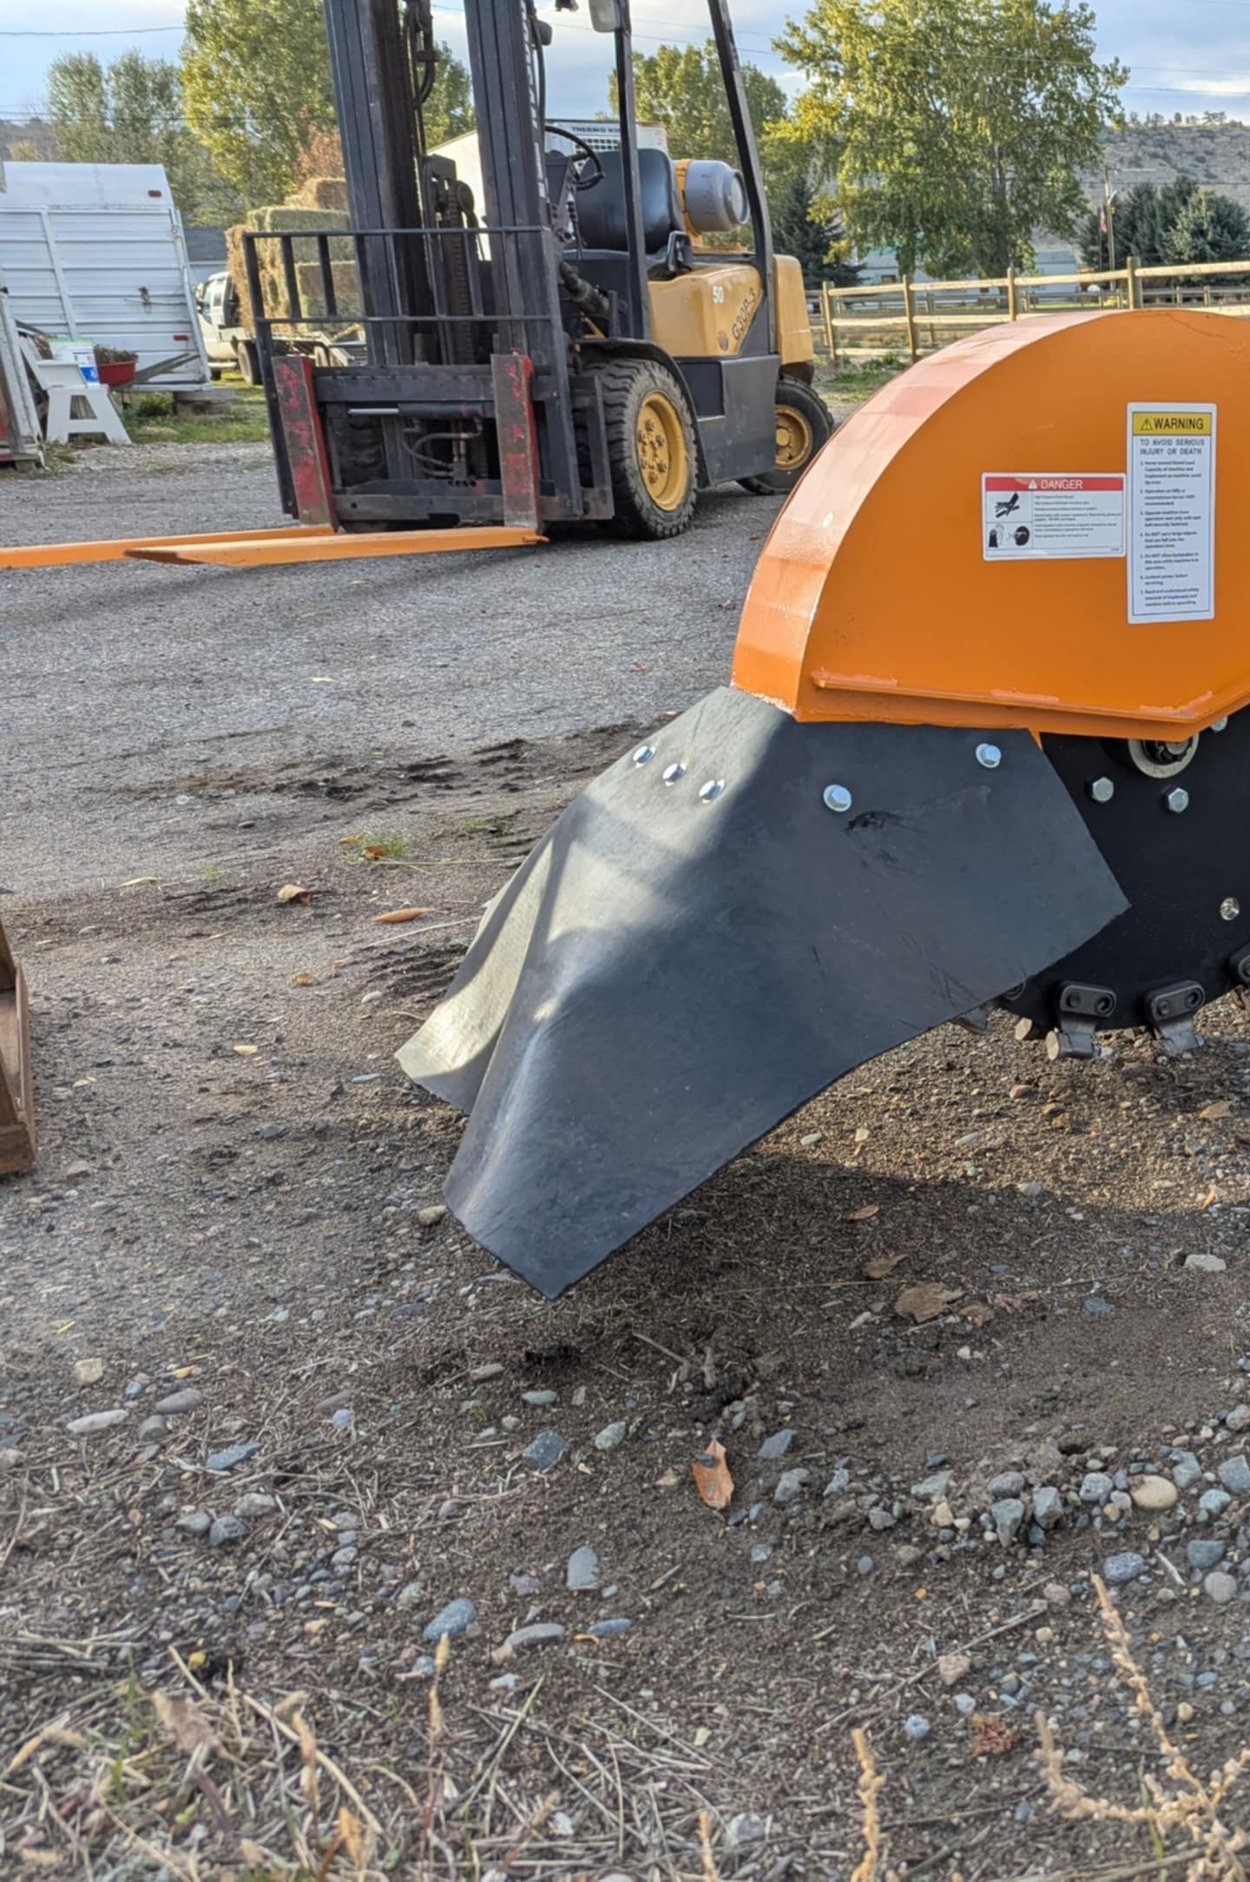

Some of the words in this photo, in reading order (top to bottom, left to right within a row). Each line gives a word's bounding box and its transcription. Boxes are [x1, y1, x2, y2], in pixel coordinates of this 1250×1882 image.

[713, 285, 724, 304] 50
[1153, 417, 1204, 431] WARNING
[1140, 438, 1150, 446] TO
[1153, 438, 1173, 446] AVOID
[1175, 438, 1205, 446] SERIOUS
[1140, 447, 1164, 455] INJURY
[1167, 447, 1177, 455] OR
[1180, 447, 1202, 455] DEATH
[1040, 478, 1084, 490] DANGER
